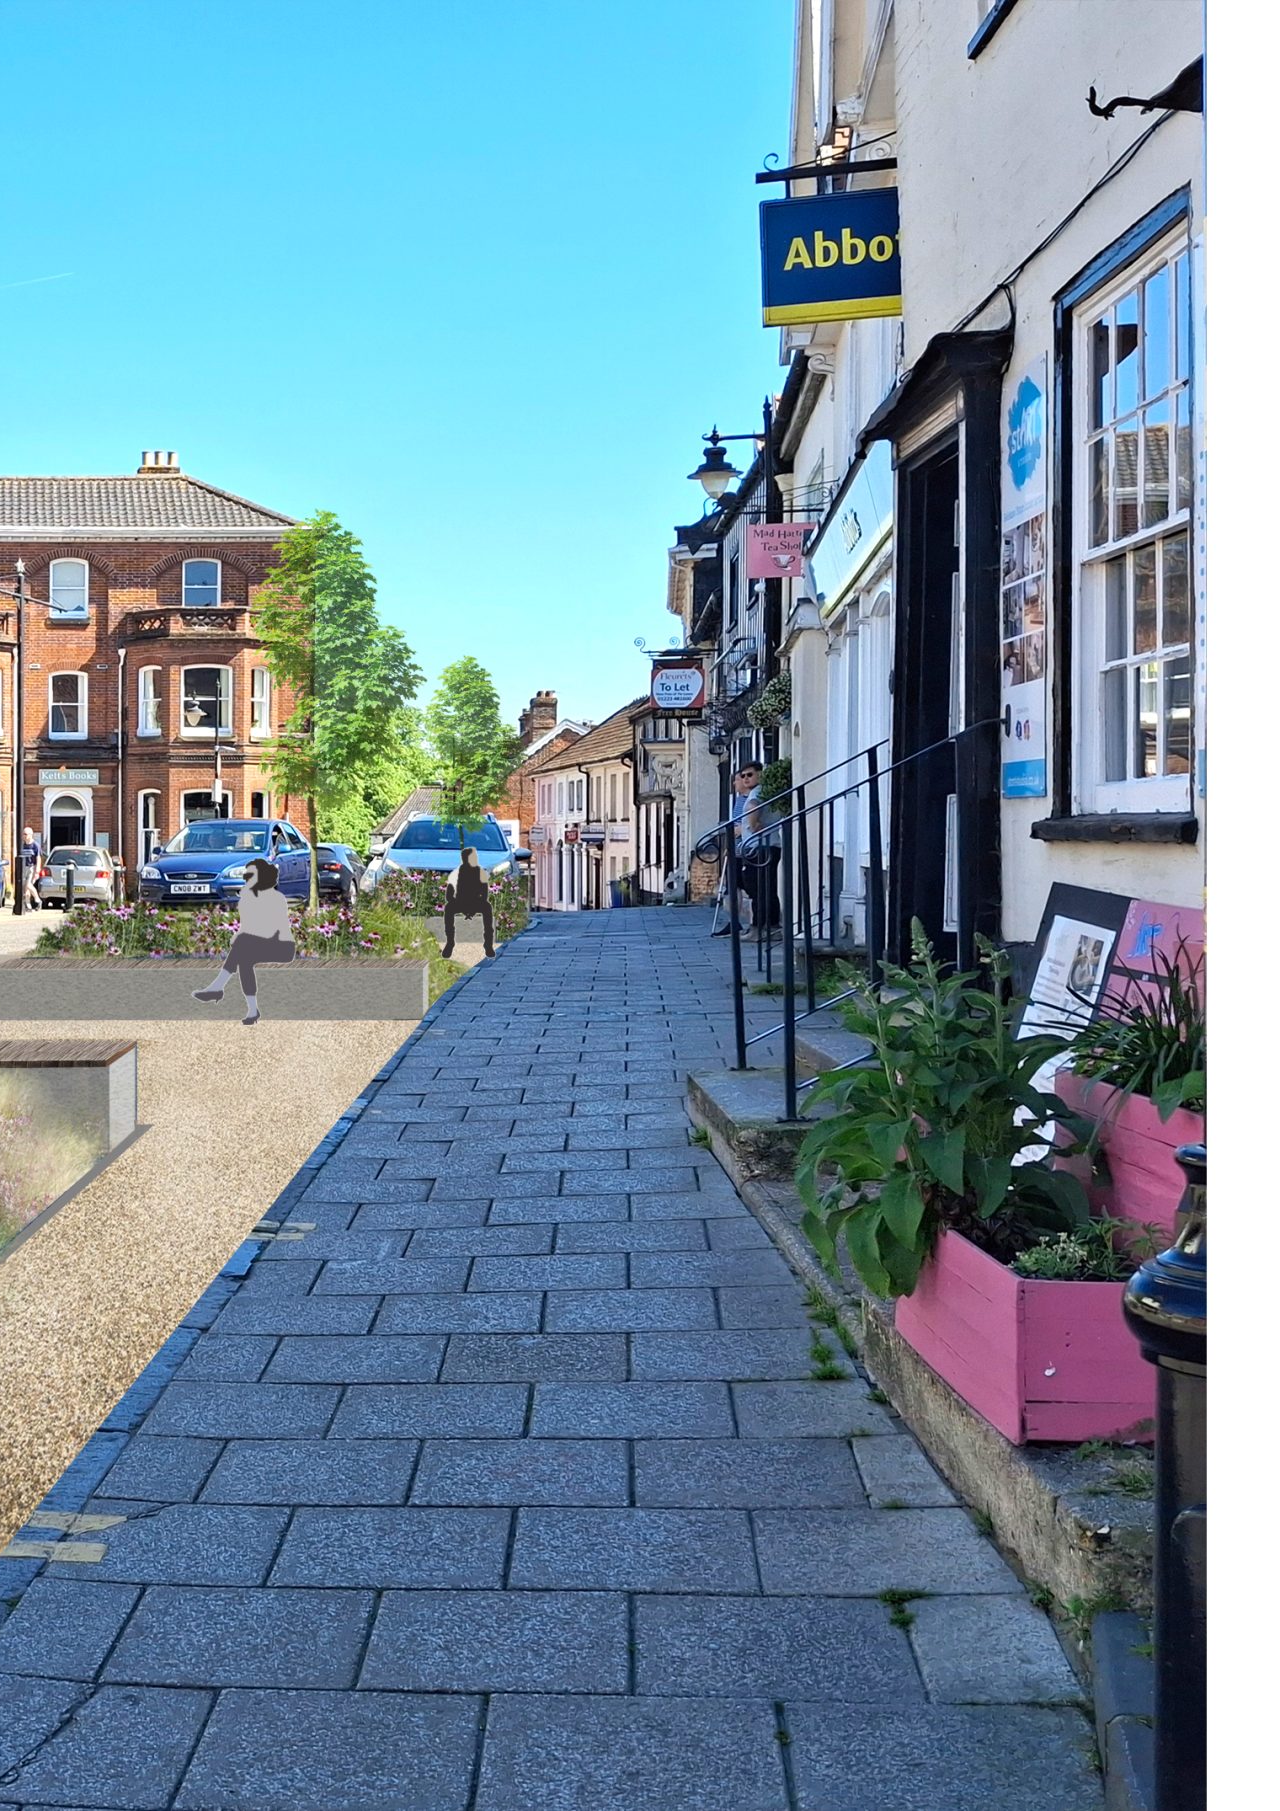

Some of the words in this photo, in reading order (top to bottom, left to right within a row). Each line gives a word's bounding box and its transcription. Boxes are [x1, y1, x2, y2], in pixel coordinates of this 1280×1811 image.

[753, 529, 775, 539] Mad
[761, 541, 779, 551] Tea
[660, 682, 671, 691] To
[674, 682, 689, 691] Let
[69, 771, 97, 780] Books
